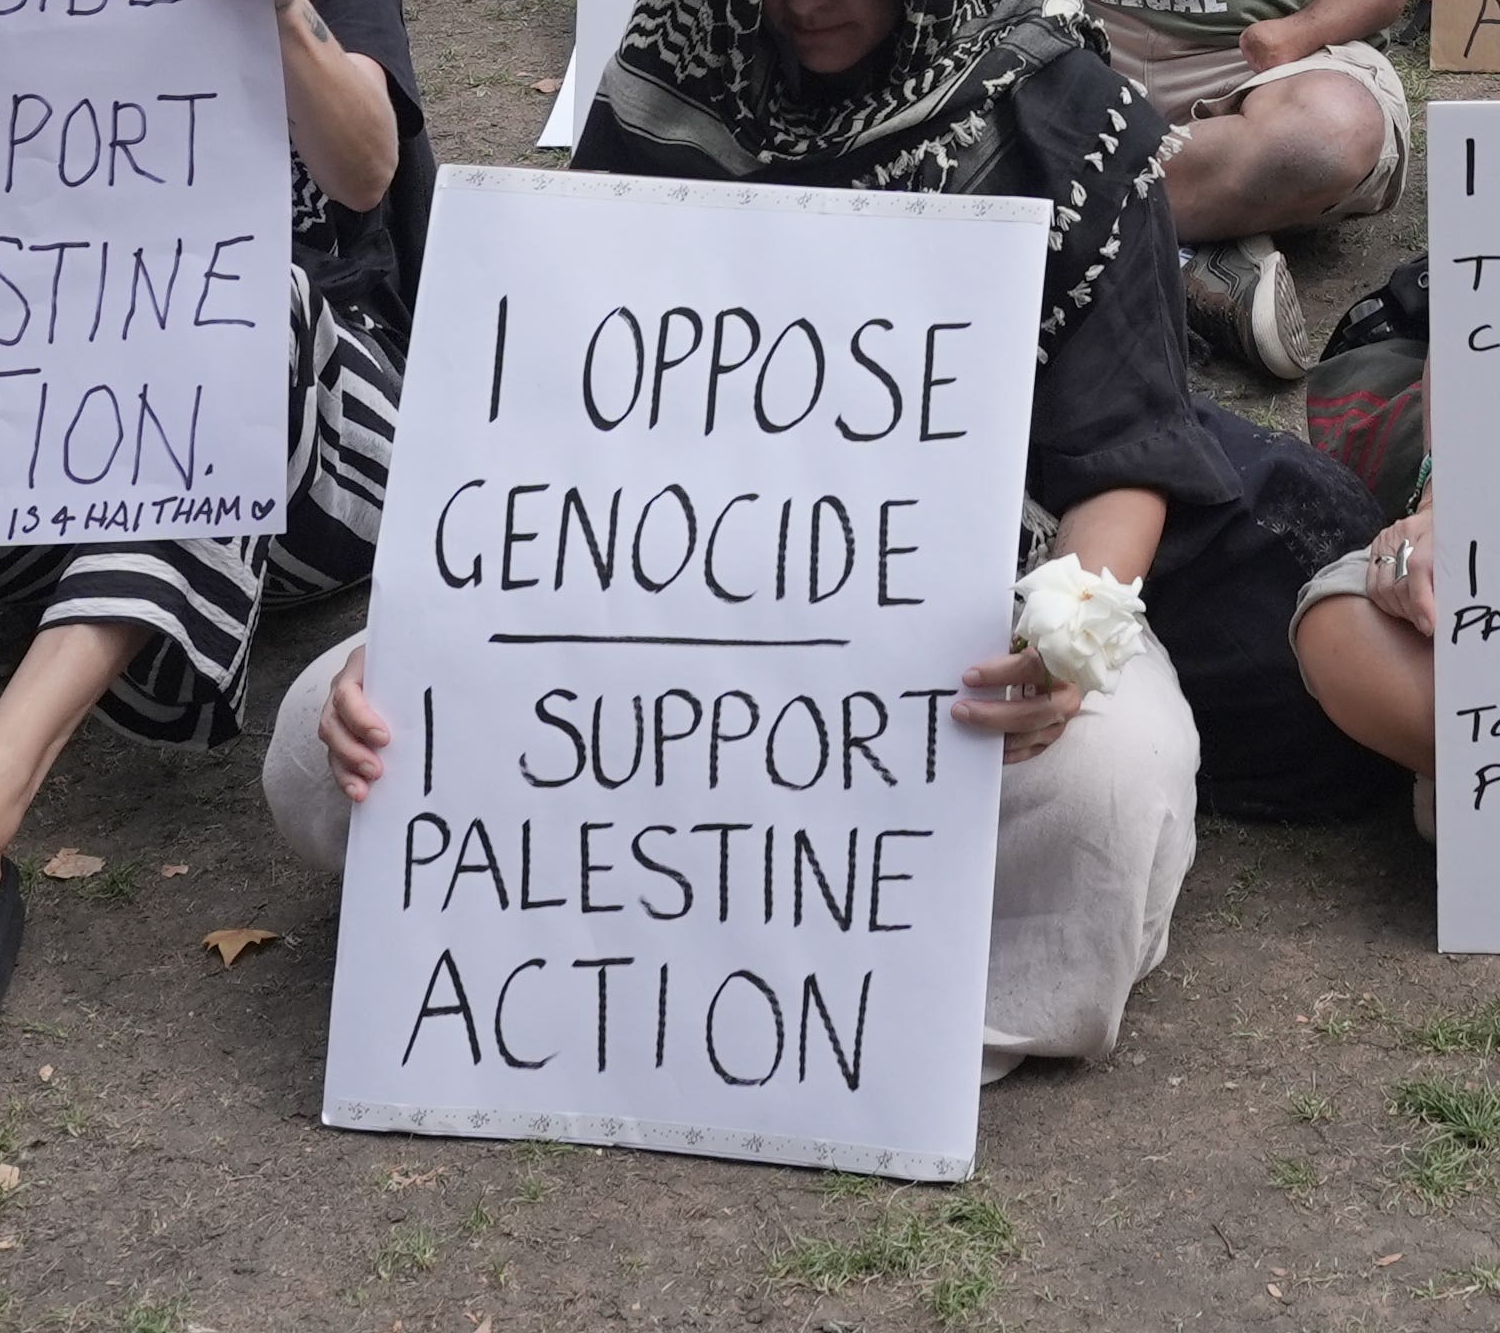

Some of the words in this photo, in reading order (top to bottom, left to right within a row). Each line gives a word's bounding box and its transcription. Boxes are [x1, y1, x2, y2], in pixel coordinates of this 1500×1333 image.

[1464, 136, 1477, 197] I
[487, 294, 510, 423] I
[580, 304, 974, 443] OPPOSE
[7, 505, 40, 540] IS
[433, 478, 927, 608] GENOCIDE
[1467, 547, 1480, 600] I
[421, 687, 436, 798] I
[517, 687, 960, 793] SUPPORT
[401, 809, 936, 935] PALESTINE
[400, 946, 874, 1091] ACTION
